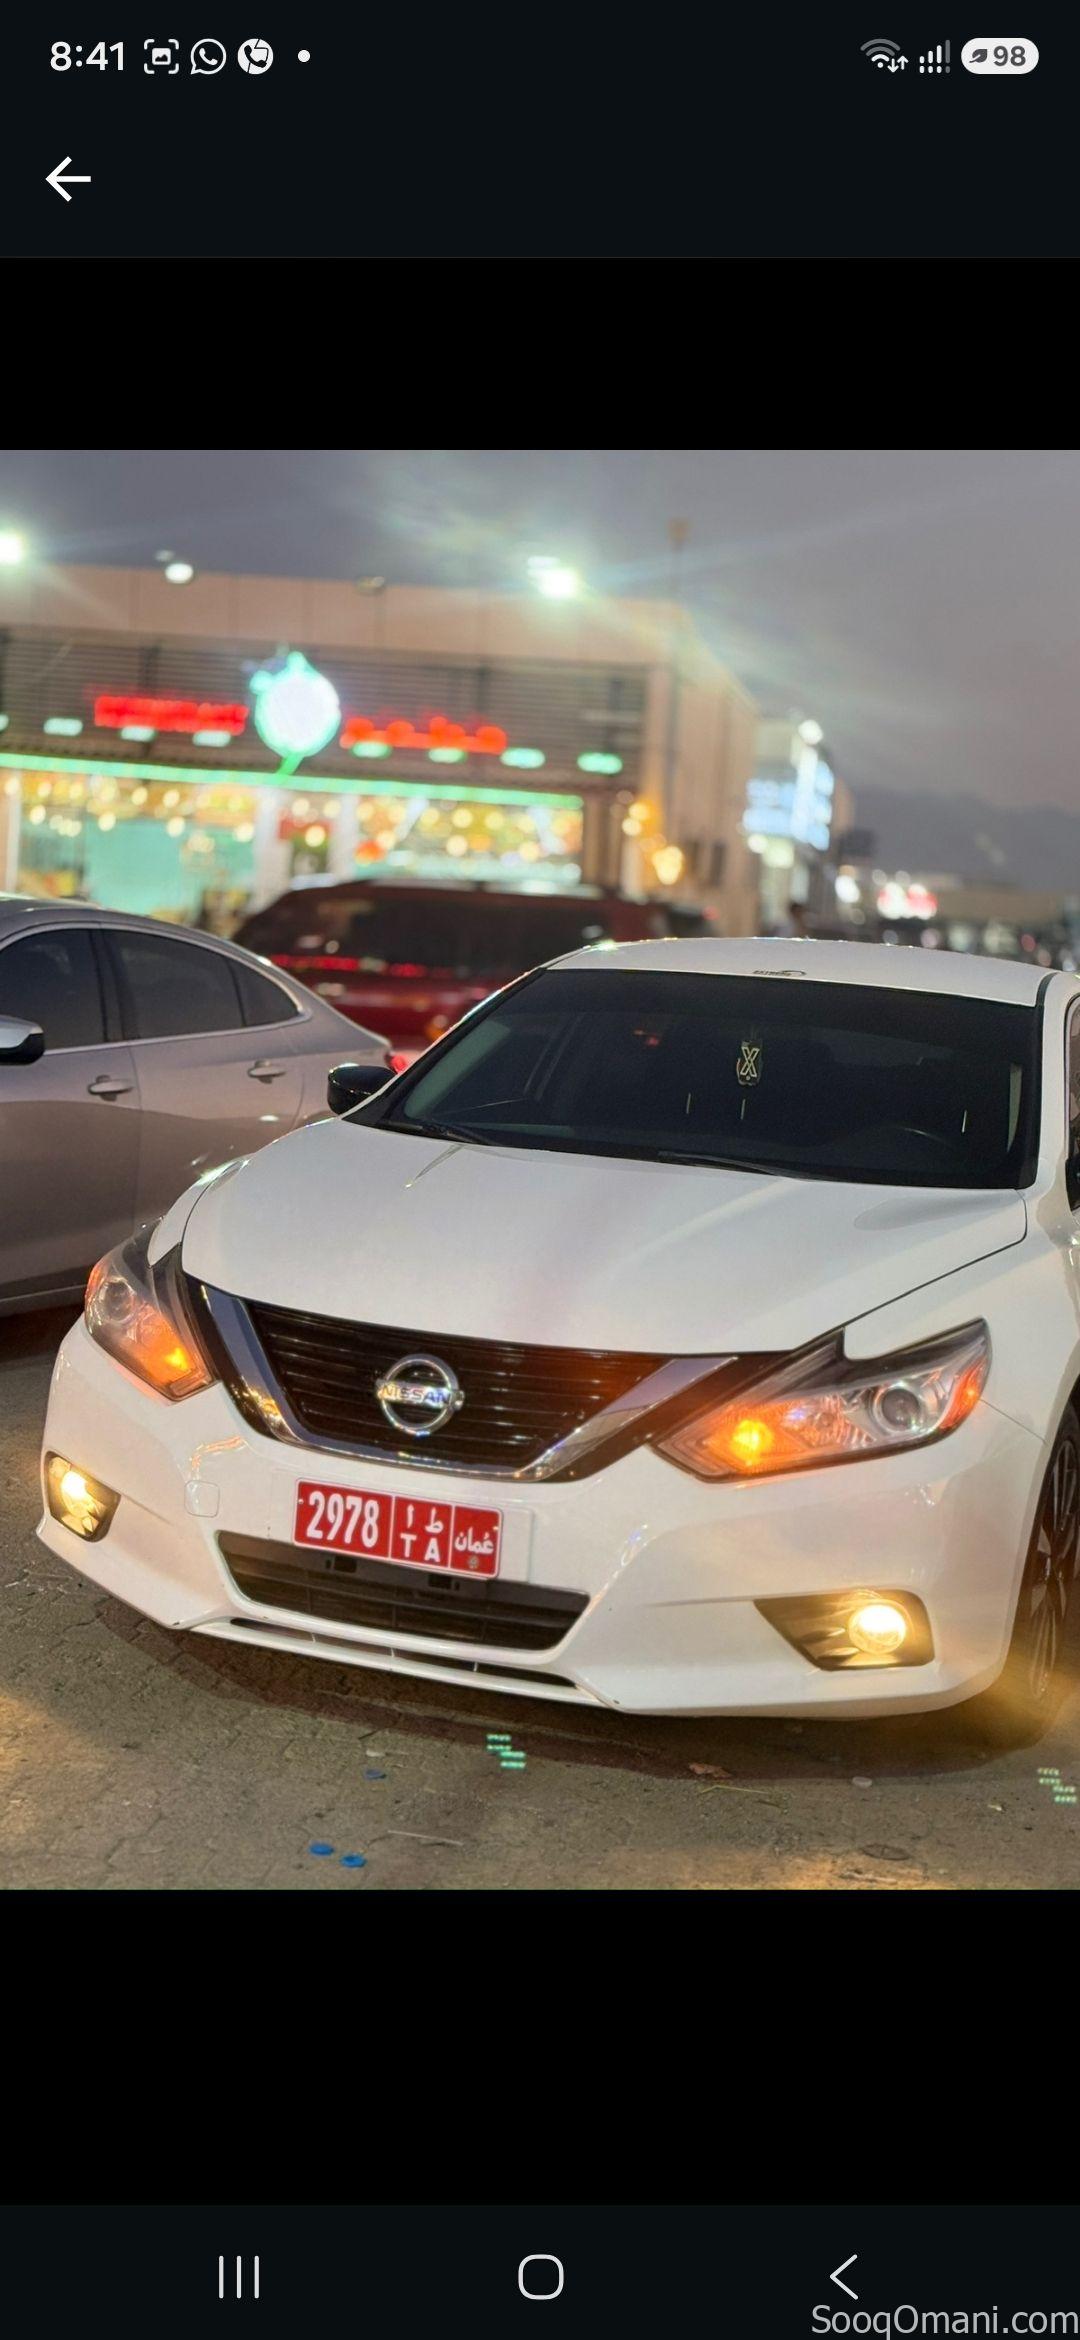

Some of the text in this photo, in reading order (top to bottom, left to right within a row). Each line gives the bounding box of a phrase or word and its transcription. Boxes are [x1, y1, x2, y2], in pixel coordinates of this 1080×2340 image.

[51, 42, 124, 71] 8:41
[993, 45, 1026, 67] 98
[381, 1384, 450, 1403] NISSAN
[306, 1490, 380, 1548] 2978
